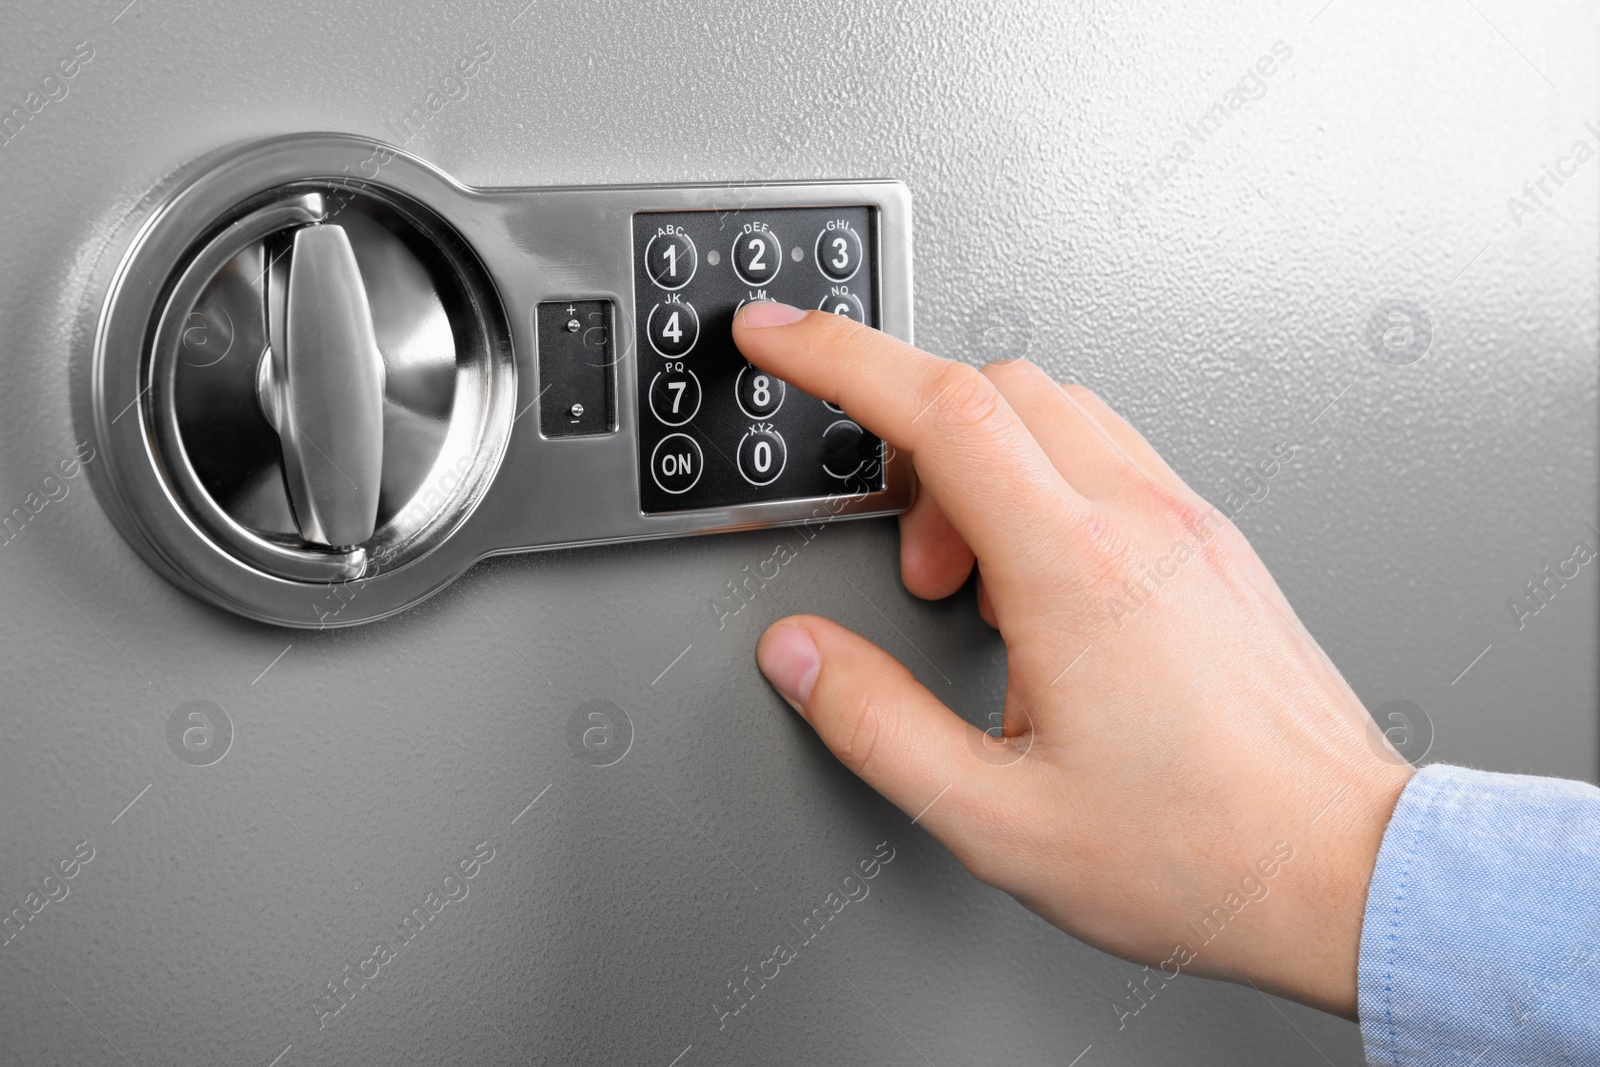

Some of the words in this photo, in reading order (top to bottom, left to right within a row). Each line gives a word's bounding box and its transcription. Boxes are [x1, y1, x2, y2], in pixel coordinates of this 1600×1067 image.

[657, 224, 684, 238] ABC
[743, 221, 769, 234] DEF
[826, 219, 850, 231] GHI
[748, 238, 766, 270] 2
[831, 237, 849, 269] 3
[663, 244, 676, 277] 1
[749, 289, 767, 301] LM
[831, 285, 849, 297] NO
[665, 293, 681, 304] JK
[662, 311, 683, 343] 4
[665, 361, 684, 373] PQ
[668, 381, 687, 414] 7
[753, 375, 771, 407] 8
[749, 422, 775, 436] XYZ
[662, 453, 692, 476] ON
